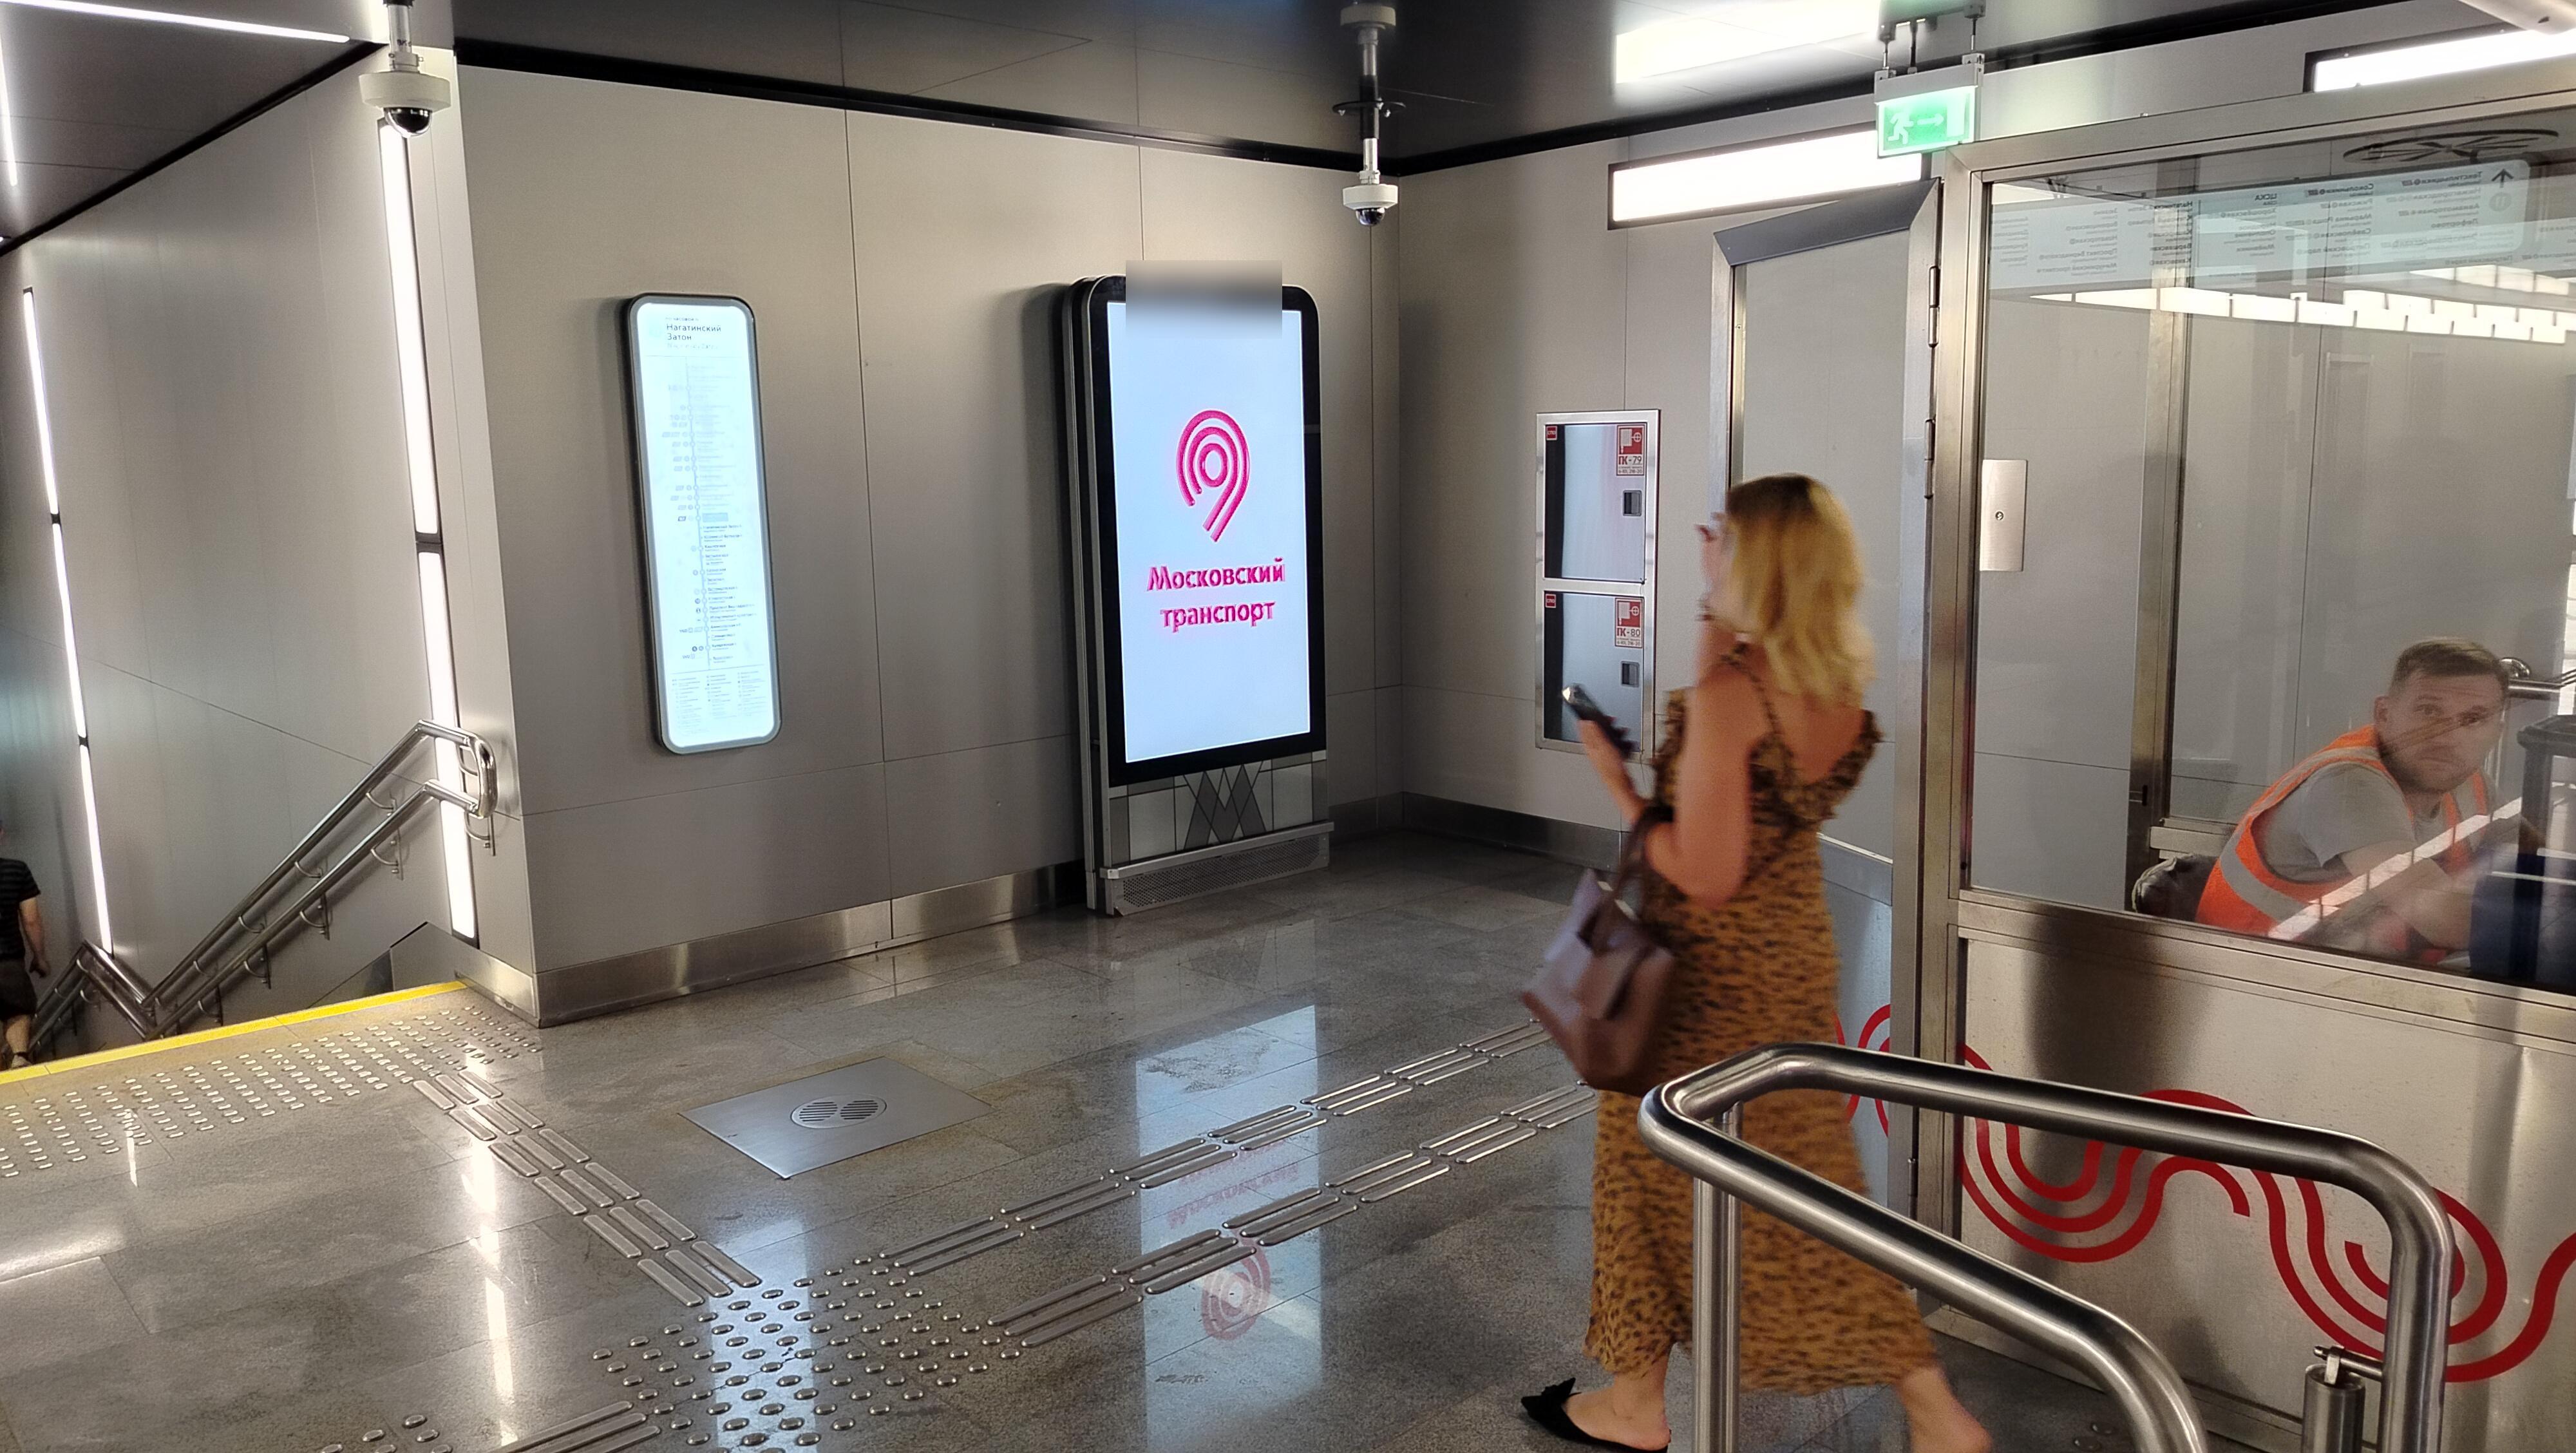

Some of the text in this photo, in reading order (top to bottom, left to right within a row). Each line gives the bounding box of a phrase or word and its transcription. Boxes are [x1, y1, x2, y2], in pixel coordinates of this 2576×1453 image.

[667, 323, 721, 332] Нагатинский
[1146, 556, 1285, 591] Московский
[1160, 602, 1276, 633] транспорт
